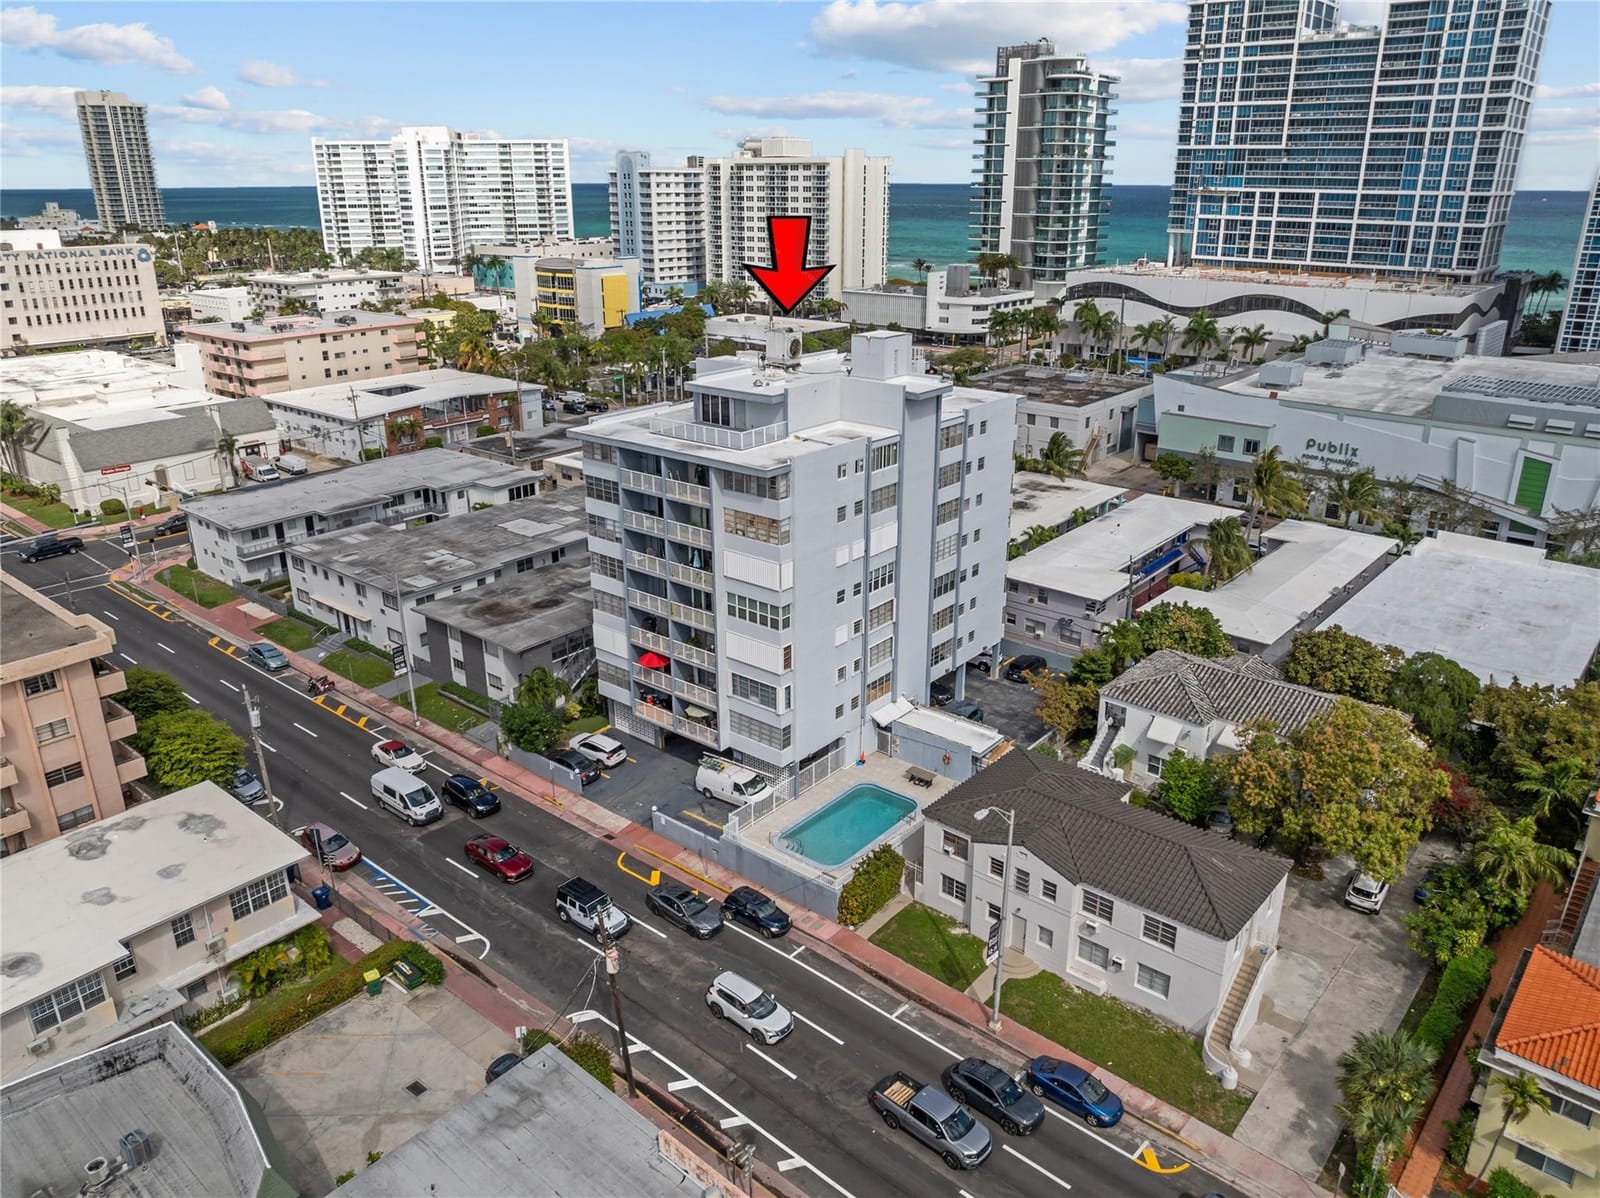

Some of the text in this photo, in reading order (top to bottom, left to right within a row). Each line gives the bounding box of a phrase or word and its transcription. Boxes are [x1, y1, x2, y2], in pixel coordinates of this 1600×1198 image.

[26, 249, 94, 260] NATIONAL
[100, 247, 134, 257] BANK
[1305, 438, 1359, 457] Publix
